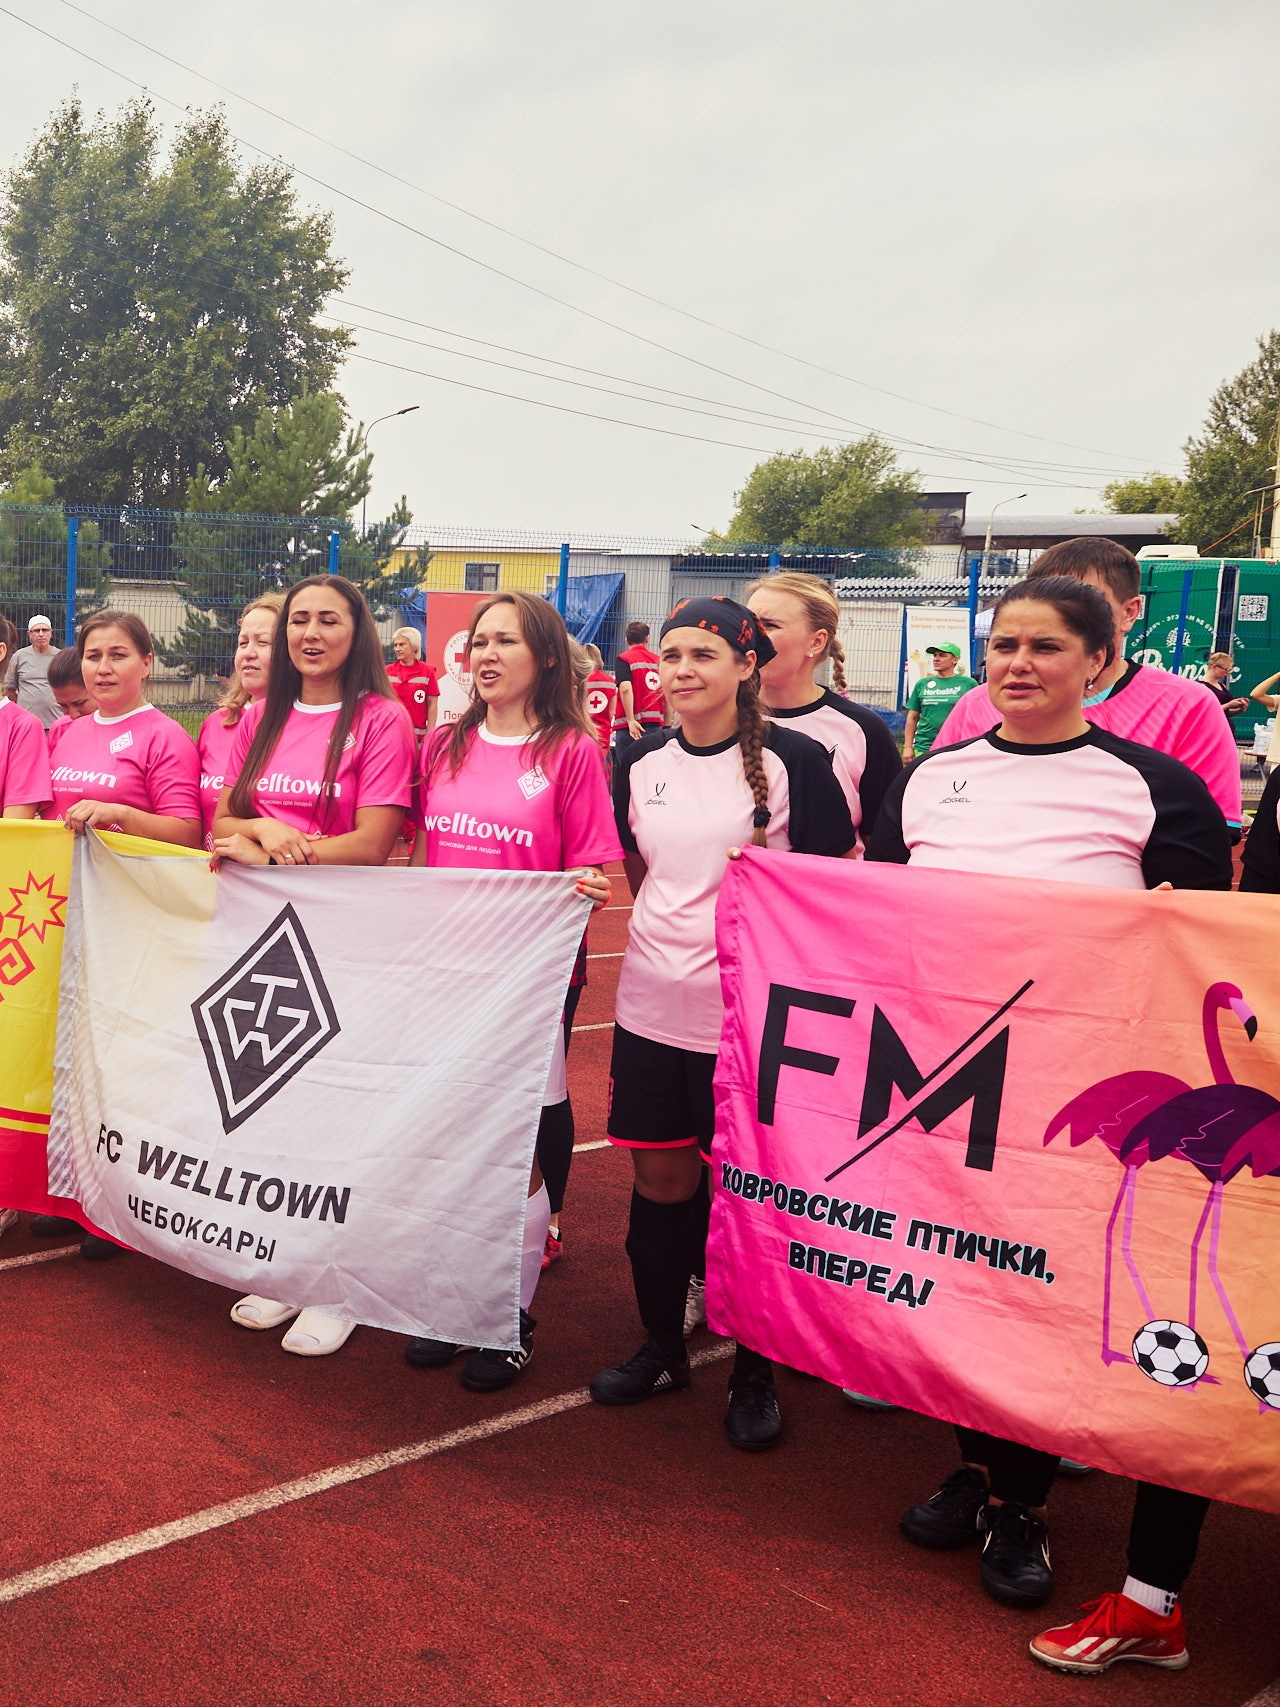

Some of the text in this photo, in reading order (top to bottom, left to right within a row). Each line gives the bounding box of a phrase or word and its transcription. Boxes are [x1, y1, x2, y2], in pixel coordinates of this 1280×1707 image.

[50, 766, 117, 789] lltown
[424, 812, 534, 848] welltown
[757, 982, 1010, 1172] FM
[96, 1123, 352, 1224] FC WELLTOWN
[127, 1194, 277, 1262] ЧЕБОКСАРЫ
[721, 1162, 1056, 1285] КОВРОВСКИЕ ПТИЧКИ,
[788, 1240, 936, 1308] ВПЕРЕД!
